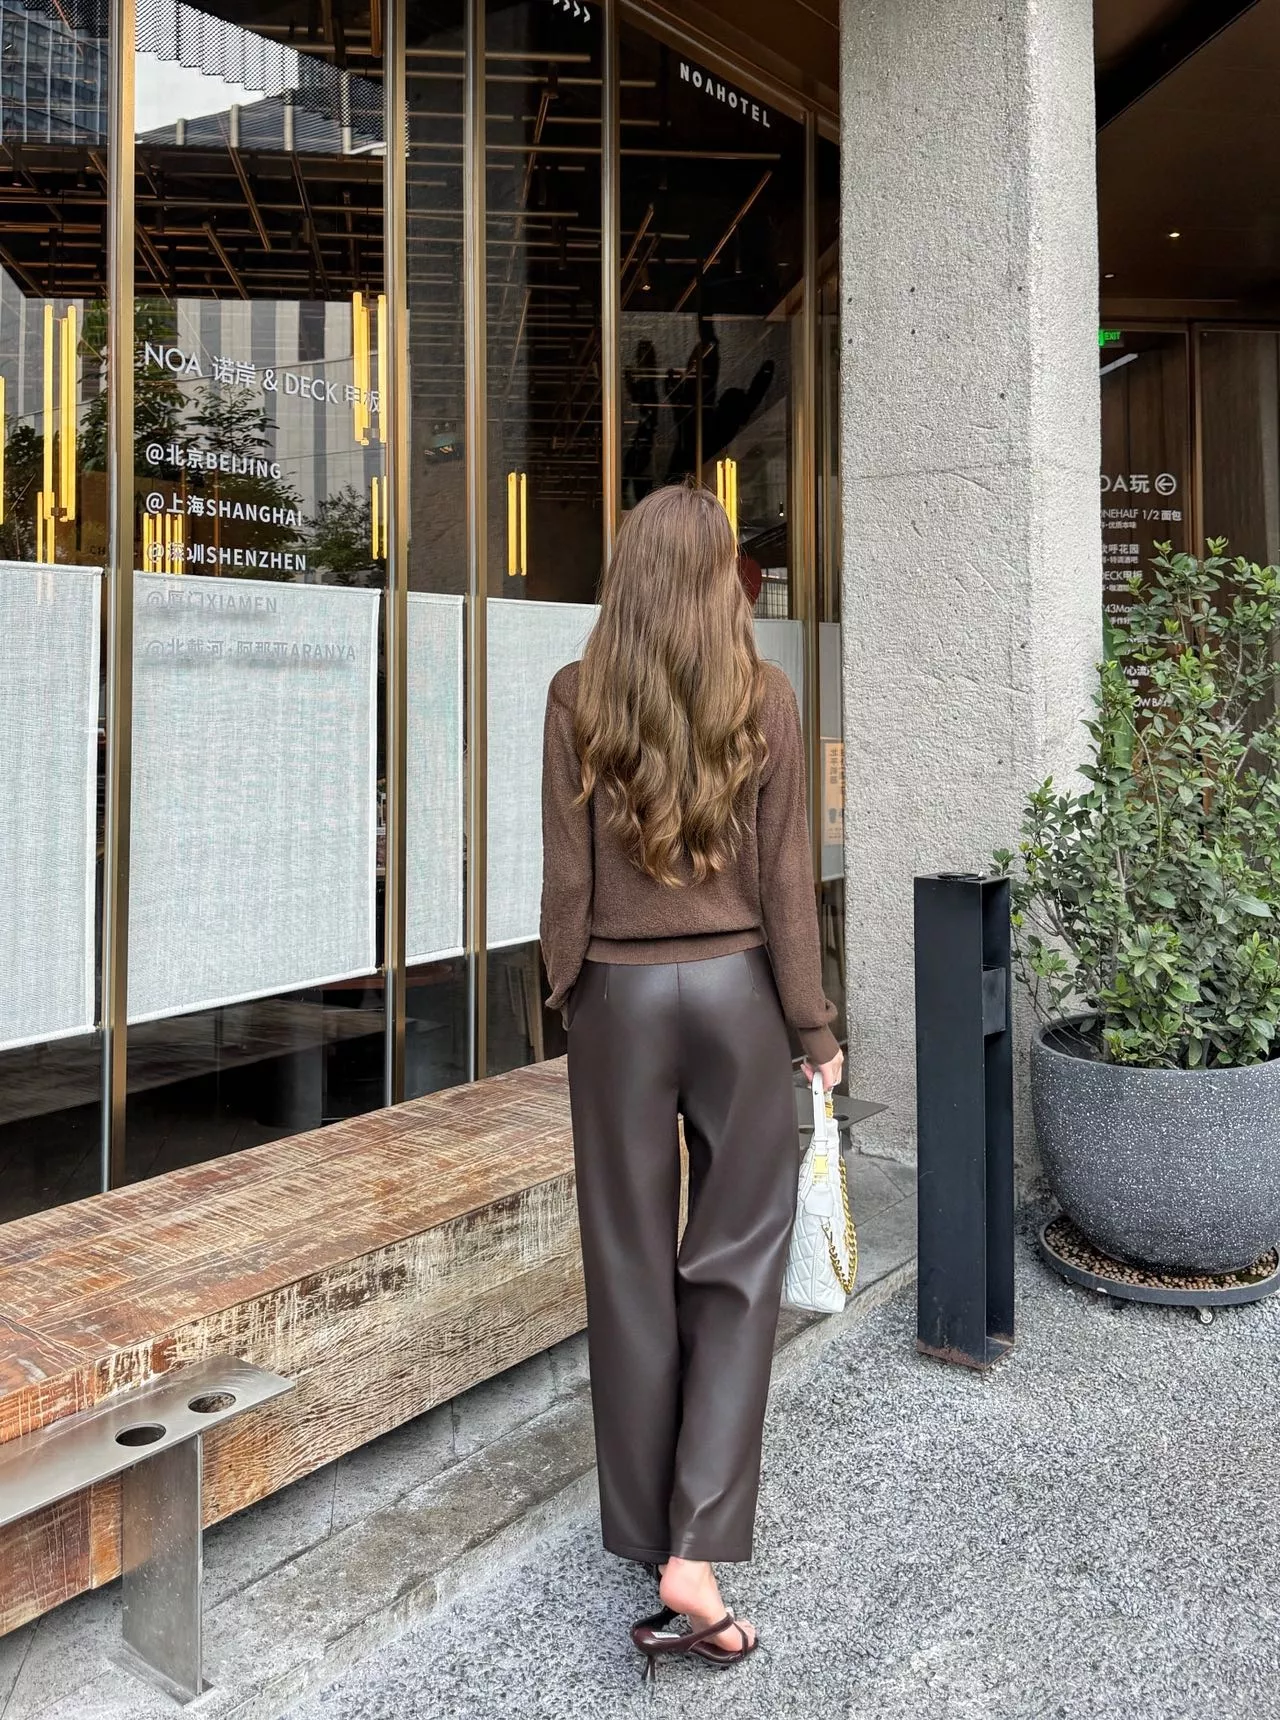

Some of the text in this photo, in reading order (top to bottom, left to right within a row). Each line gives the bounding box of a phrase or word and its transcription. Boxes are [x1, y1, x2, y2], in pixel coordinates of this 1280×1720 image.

[144, 341, 203, 378] NOA
[211, 355, 257, 387] 诺岸
[263, 369, 279, 392] &
[285, 373, 338, 404] DECK
[1100, 508, 1139, 519] NEHALF
